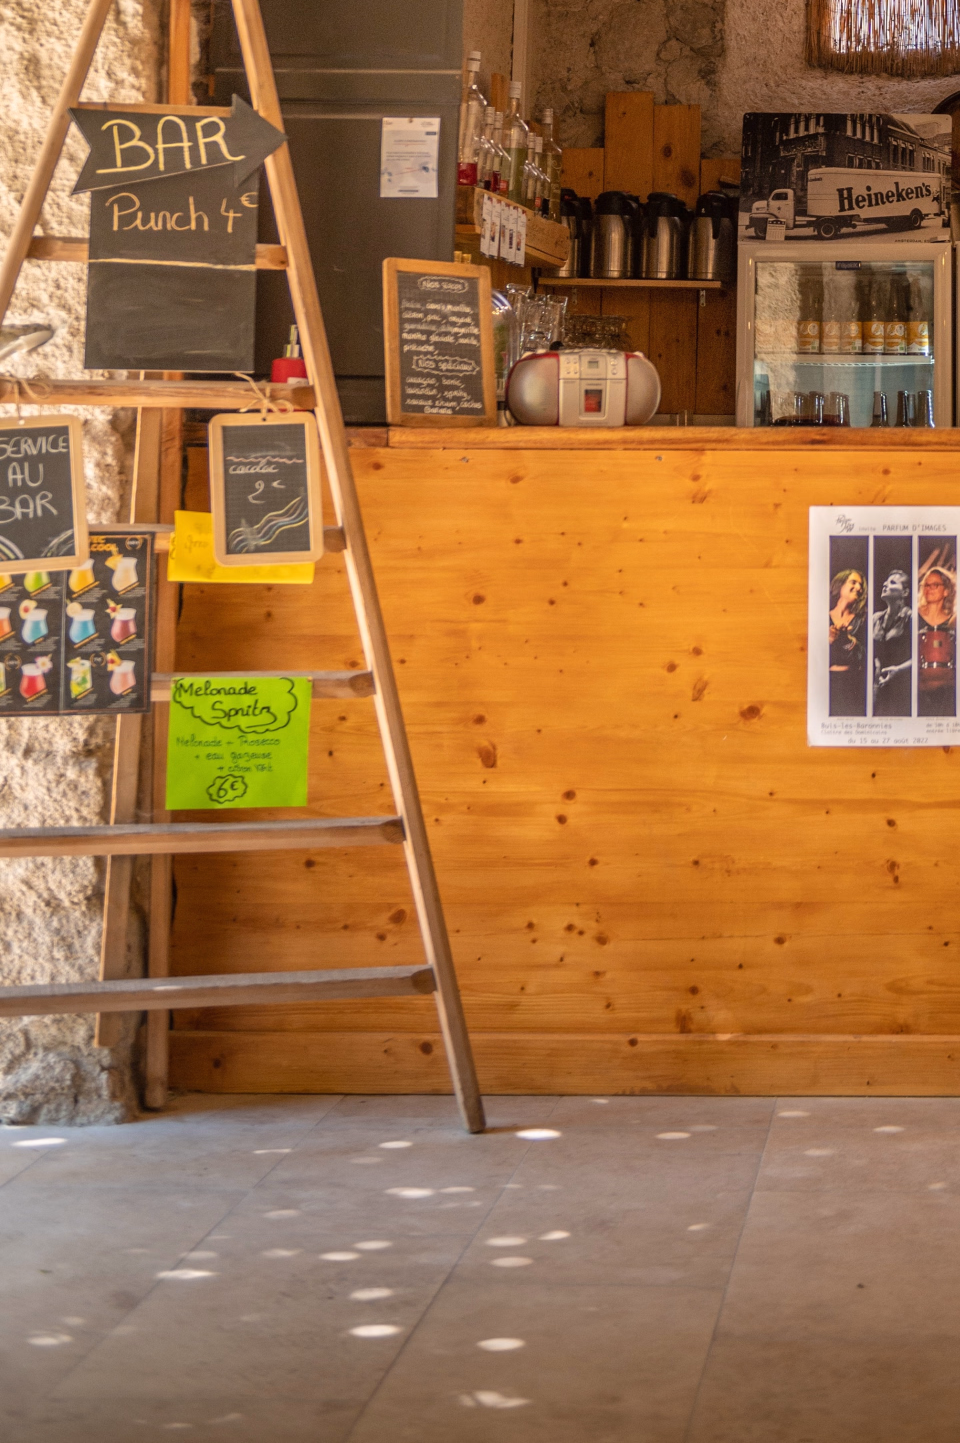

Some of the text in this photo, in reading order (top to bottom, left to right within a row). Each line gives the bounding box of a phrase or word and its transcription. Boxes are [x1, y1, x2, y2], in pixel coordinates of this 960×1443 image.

[96, 116, 246, 174] BAR
[836, 182, 931, 212] Heineken's
[106, 192, 209, 231] Punch
[0, 435, 69, 459] SERVICE
[8, 462, 43, 487] AU
[882, 524, 909, 532] PARFUM
[912, 524, 947, 532] D'IMAGES
[180, 680, 257, 697] Melonade
